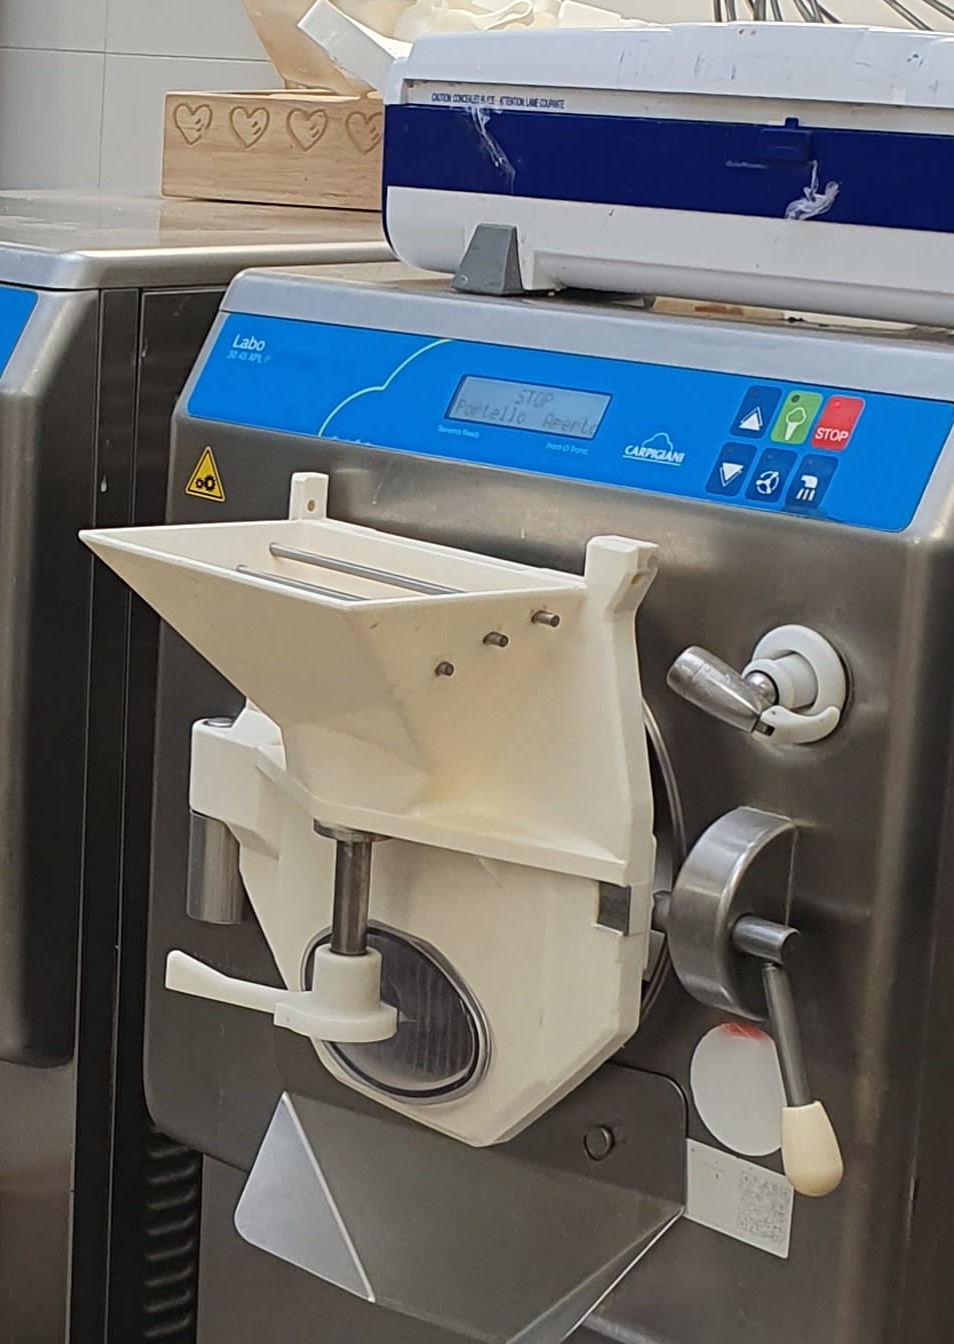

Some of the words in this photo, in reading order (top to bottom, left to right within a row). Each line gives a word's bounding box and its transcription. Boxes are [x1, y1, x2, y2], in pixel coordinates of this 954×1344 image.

[233, 334, 266, 351] Labo
[514, 389, 555, 409] STOP
[455, 399, 526, 425] Portello
[815, 427, 849, 442] STOP
[625, 444, 685, 463] CARPIGIANI
